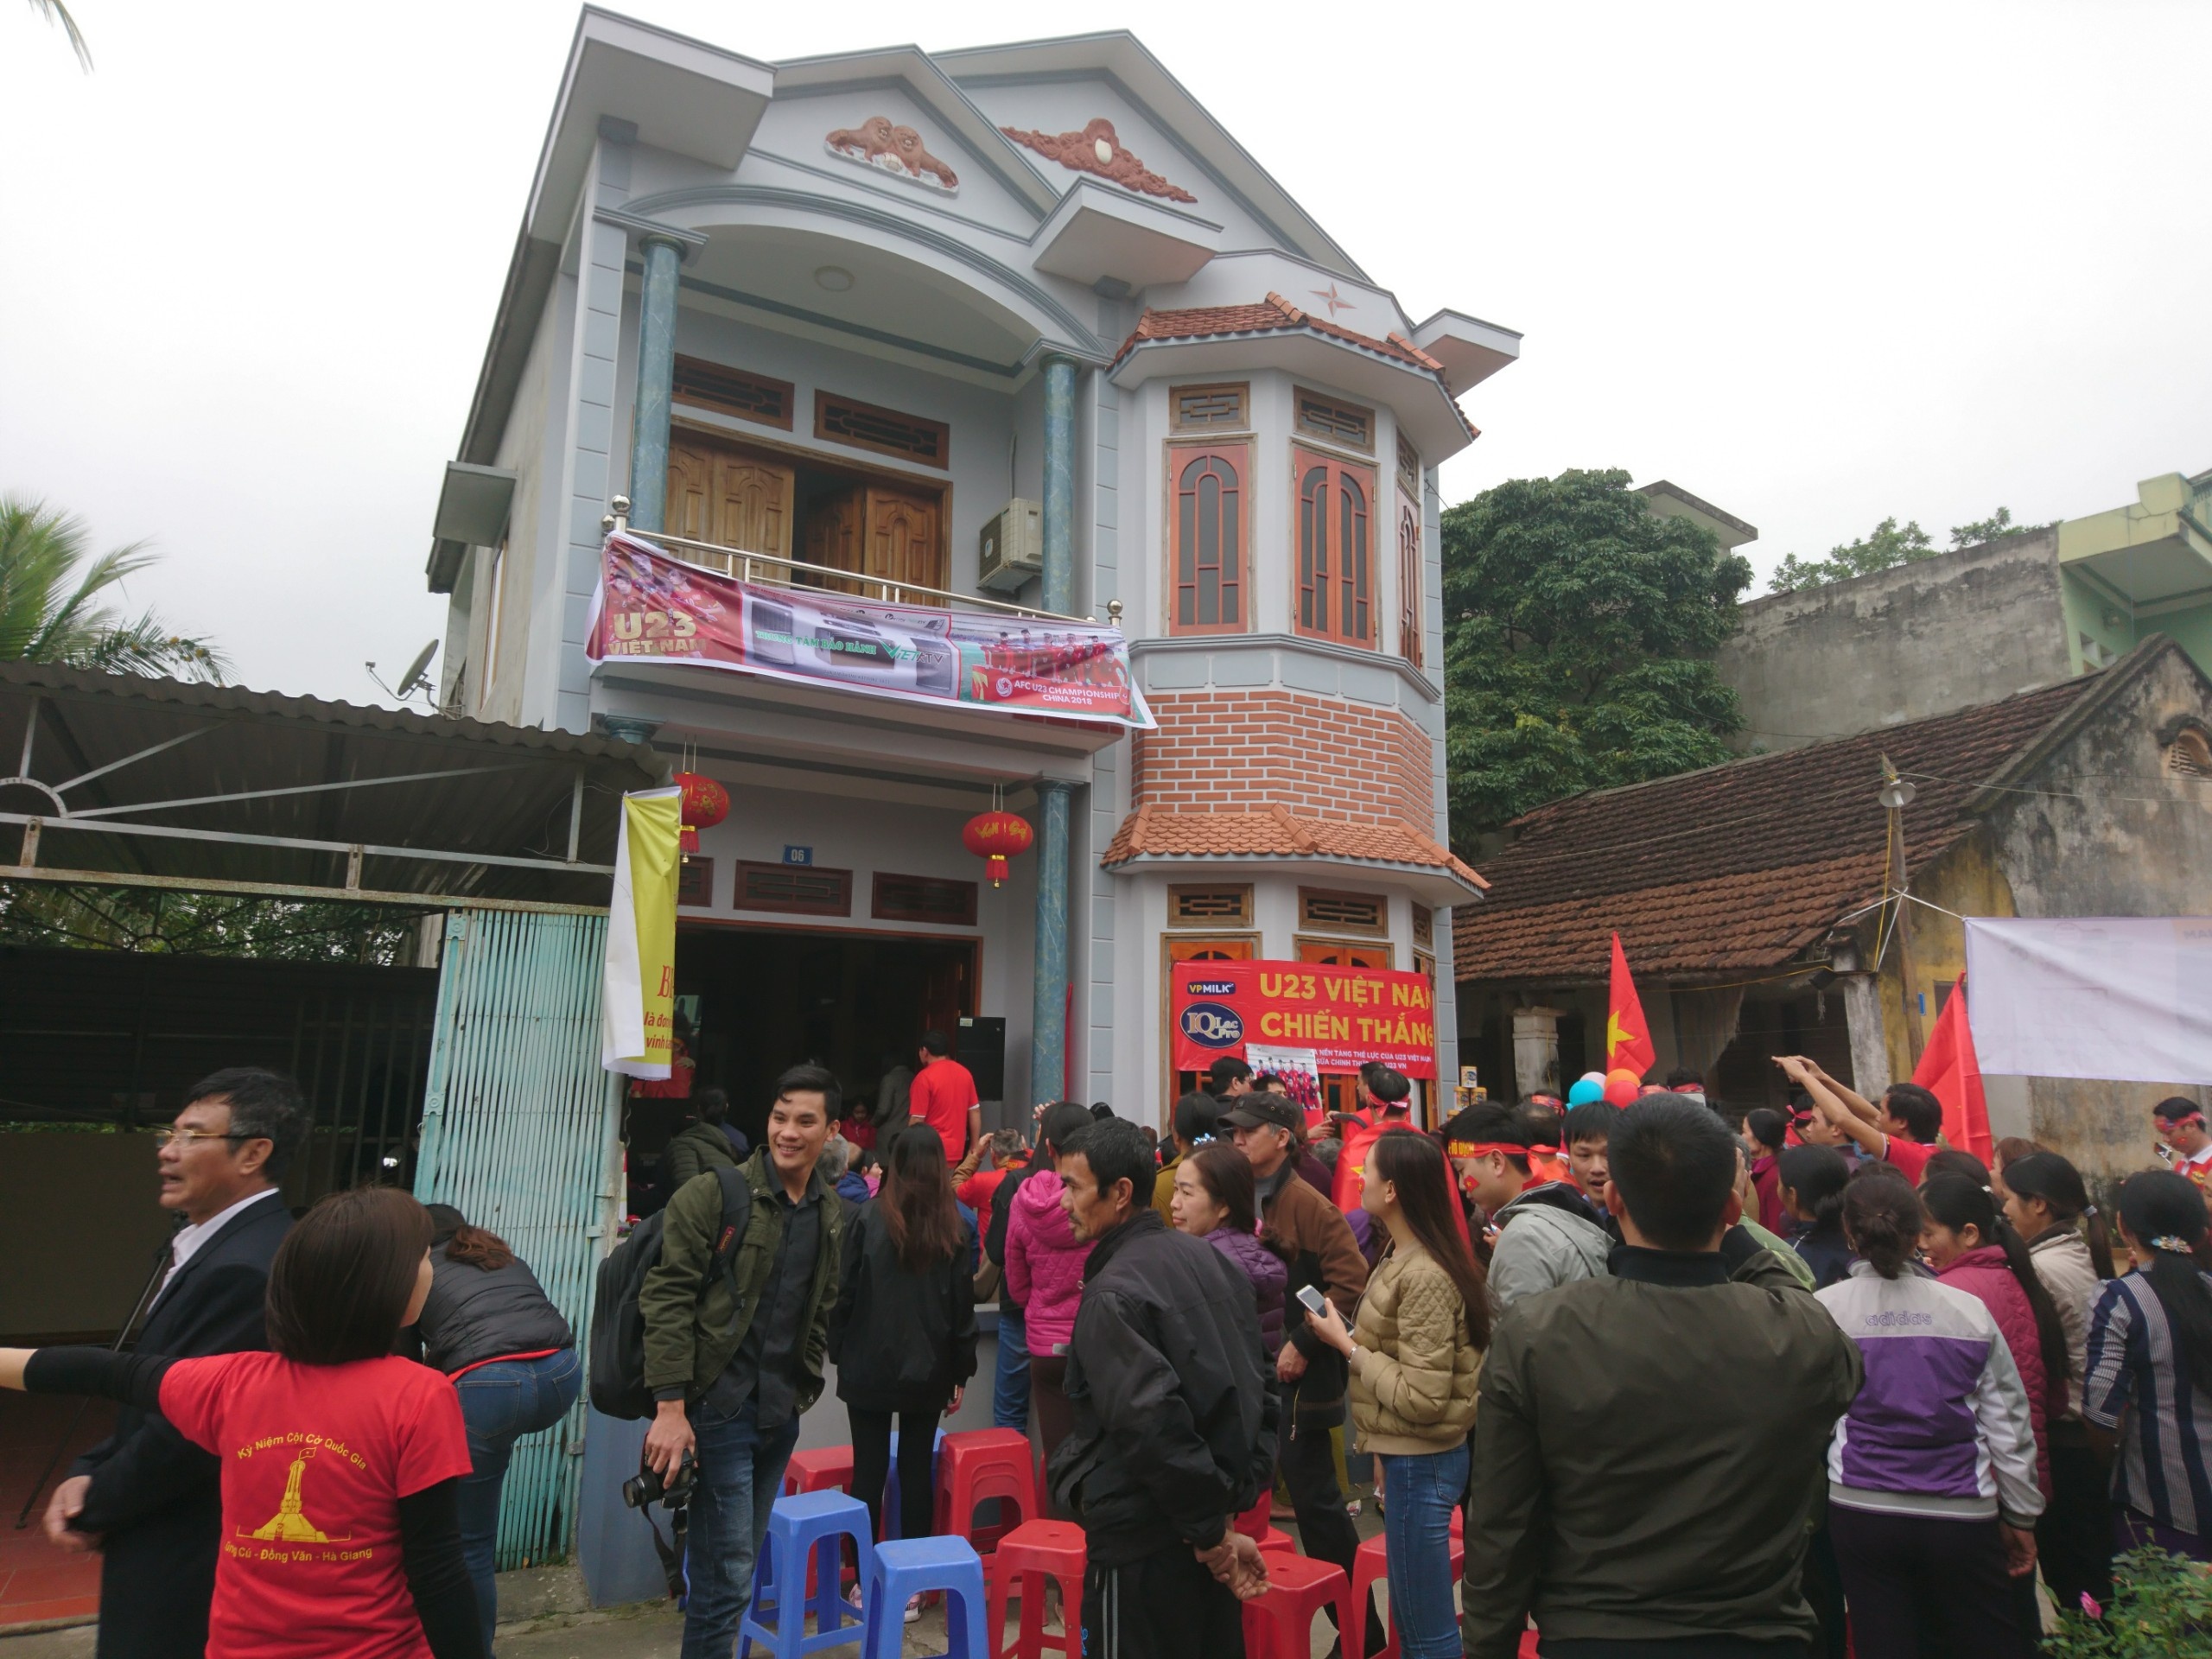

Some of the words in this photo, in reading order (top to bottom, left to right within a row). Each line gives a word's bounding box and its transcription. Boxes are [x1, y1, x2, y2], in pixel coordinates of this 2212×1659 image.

[613, 611, 696, 640] U23
[608, 639, 653, 655] VIỆT
[659, 638, 707, 652] NAM
[755, 629, 792, 644] TRUNG
[796, 634, 820, 648] TÂM
[821, 636, 844, 651] BẢO
[846, 639, 876, 655] HÀNH
[1014, 680, 1031, 690] AFC
[1032, 683, 1047, 693] U23
[1049, 686, 1120, 700] CHAMPIONSHIP
[1042, 695, 1071, 703] CHINA
[1071, 696, 1092, 705] 2018
[791, 849, 804, 862] 06
[1189, 983, 1234, 994] VPMILK
[1260, 973, 1316, 1000] U23
[1324, 975, 1384, 1007] VIỆT
[644, 1011, 655, 1027] là
[1186, 1012, 1222, 1039] IQ
[1260, 1008, 1350, 1040] CHIẾN
[1357, 1012, 1434, 1046] THẮNG
[1218, 1028, 1241, 1039] Pro
[1866, 1311, 1932, 1326] adidas
[255, 1436, 283, 1451] Niệm
[287, 1432, 302, 1445] Cột
[324, 1438, 349, 1457] Quốc
[350, 1453, 366, 1470] Gia
[225, 1541, 237, 1557] ũng
[322, 1551, 336, 1561] Hà
[340, 1548, 372, 1560] Giang
